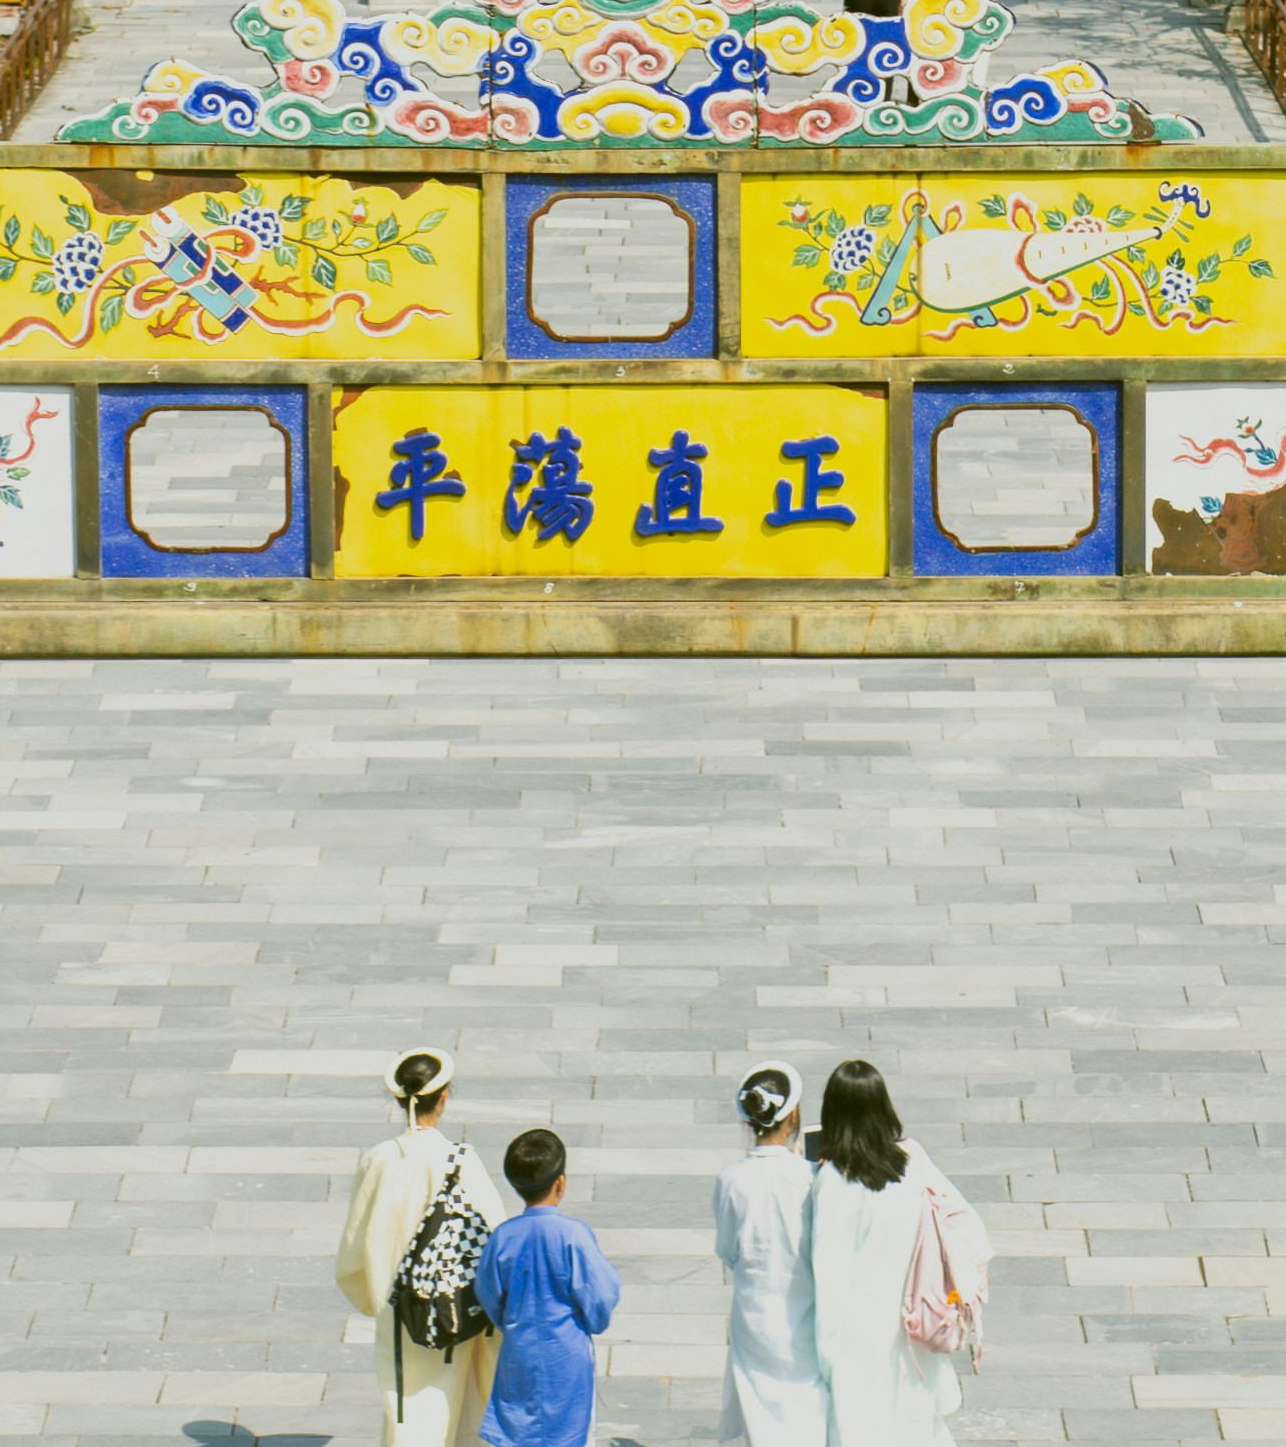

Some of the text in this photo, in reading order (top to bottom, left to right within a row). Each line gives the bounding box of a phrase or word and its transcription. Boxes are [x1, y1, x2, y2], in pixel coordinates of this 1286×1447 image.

[147, 364, 161, 379] 4
[1002, 363, 1015, 374] 2
[183, 581, 197, 593] 9
[543, 582, 555, 594] 8
